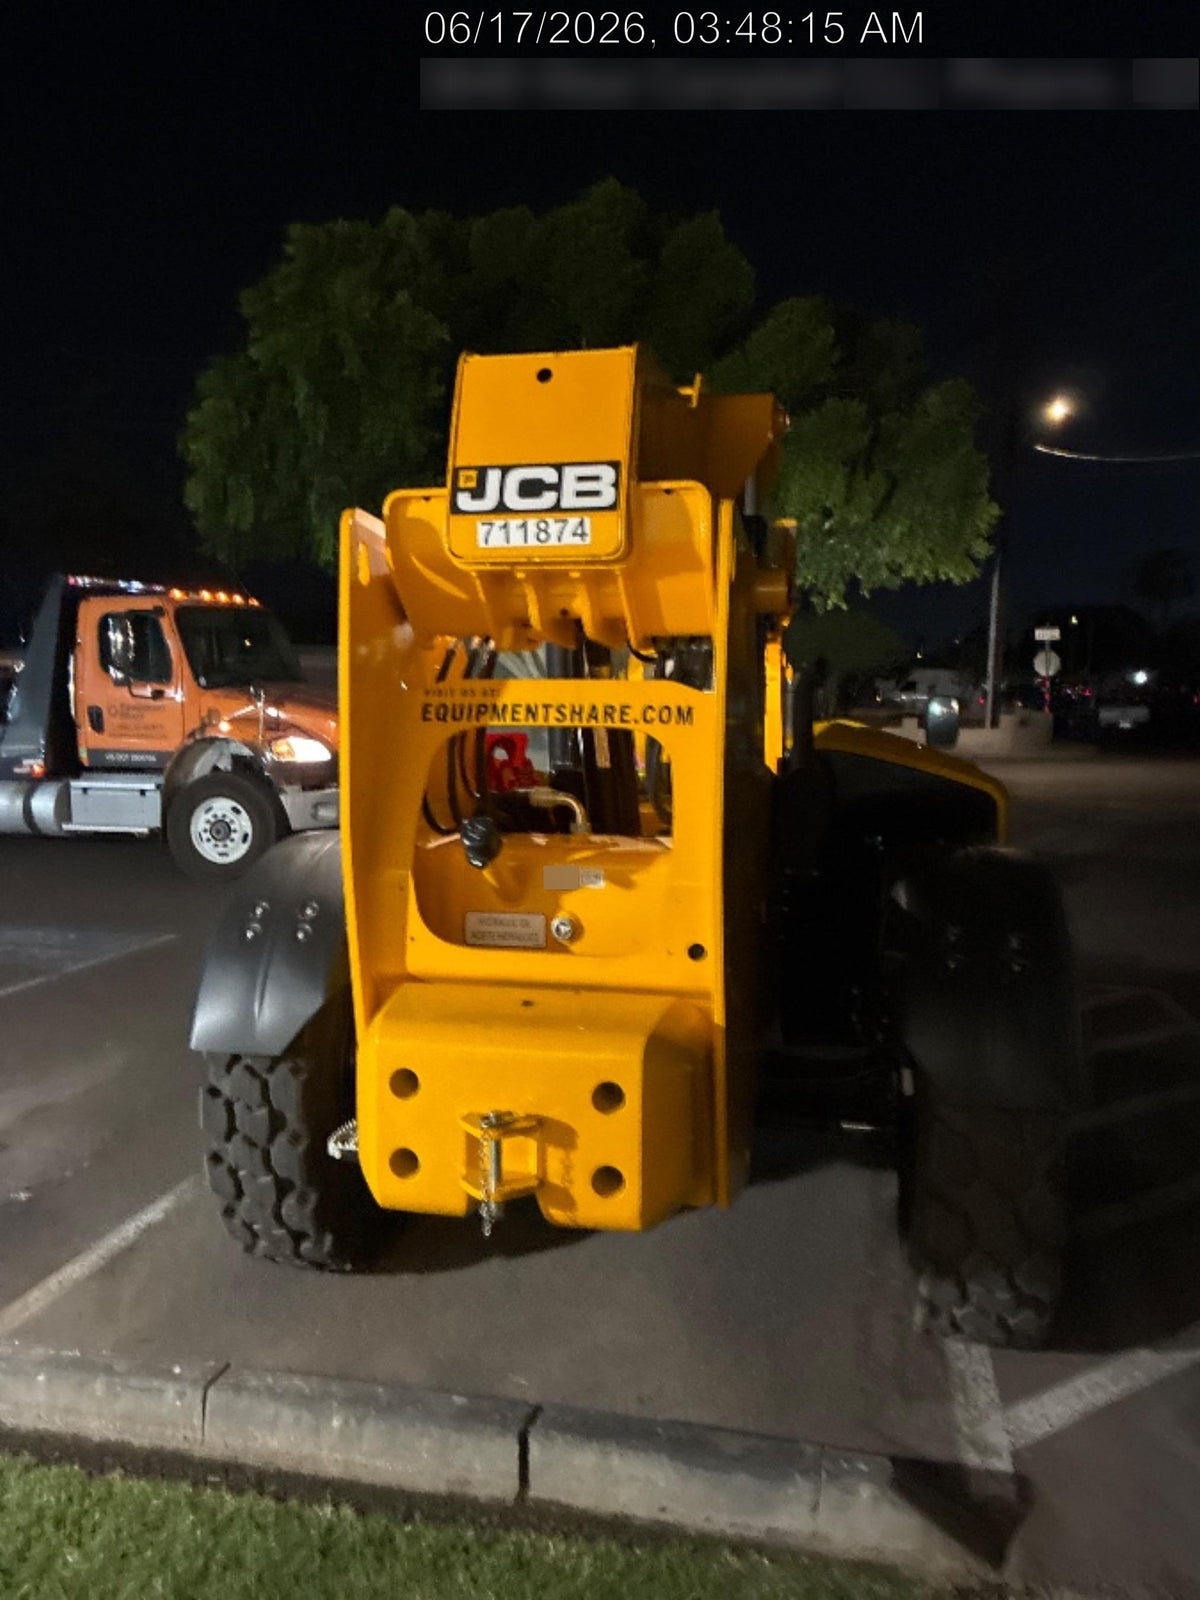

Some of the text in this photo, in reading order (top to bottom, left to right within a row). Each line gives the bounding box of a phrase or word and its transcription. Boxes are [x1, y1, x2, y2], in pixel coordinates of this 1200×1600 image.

[456, 464, 616, 512] JCB
[481, 517, 588, 545] 711874
[421, 702, 694, 726] EQUIPMENTSHARE.COM
